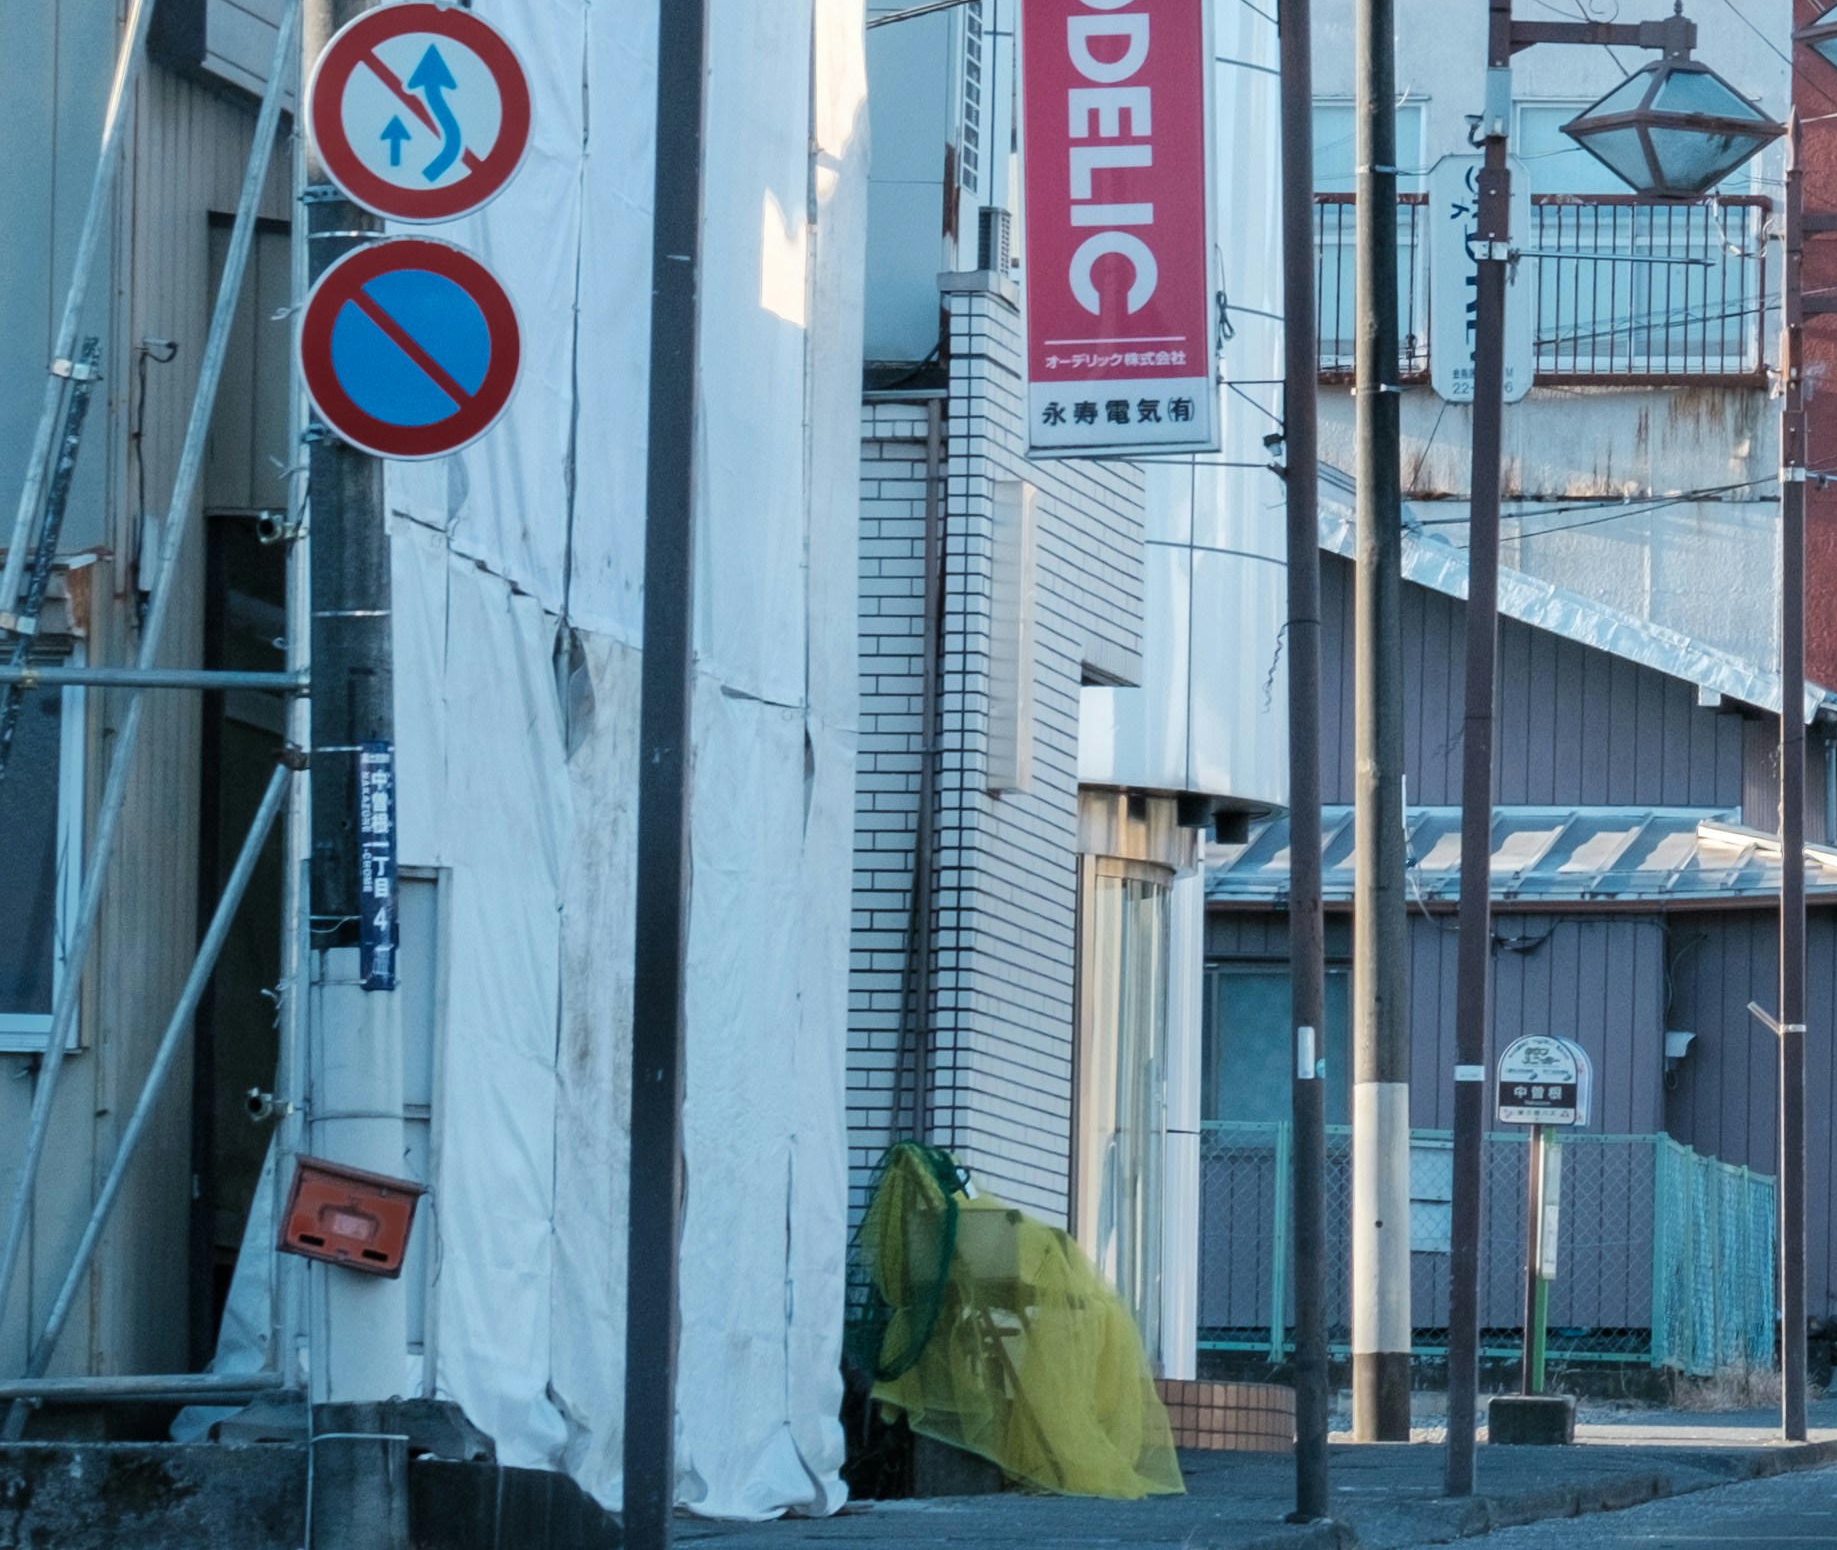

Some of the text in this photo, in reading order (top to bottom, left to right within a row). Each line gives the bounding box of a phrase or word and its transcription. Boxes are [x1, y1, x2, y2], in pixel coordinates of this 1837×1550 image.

[1045, 350, 1187, 369] オーデリック株式会社
[373, 907, 389, 931] 4
